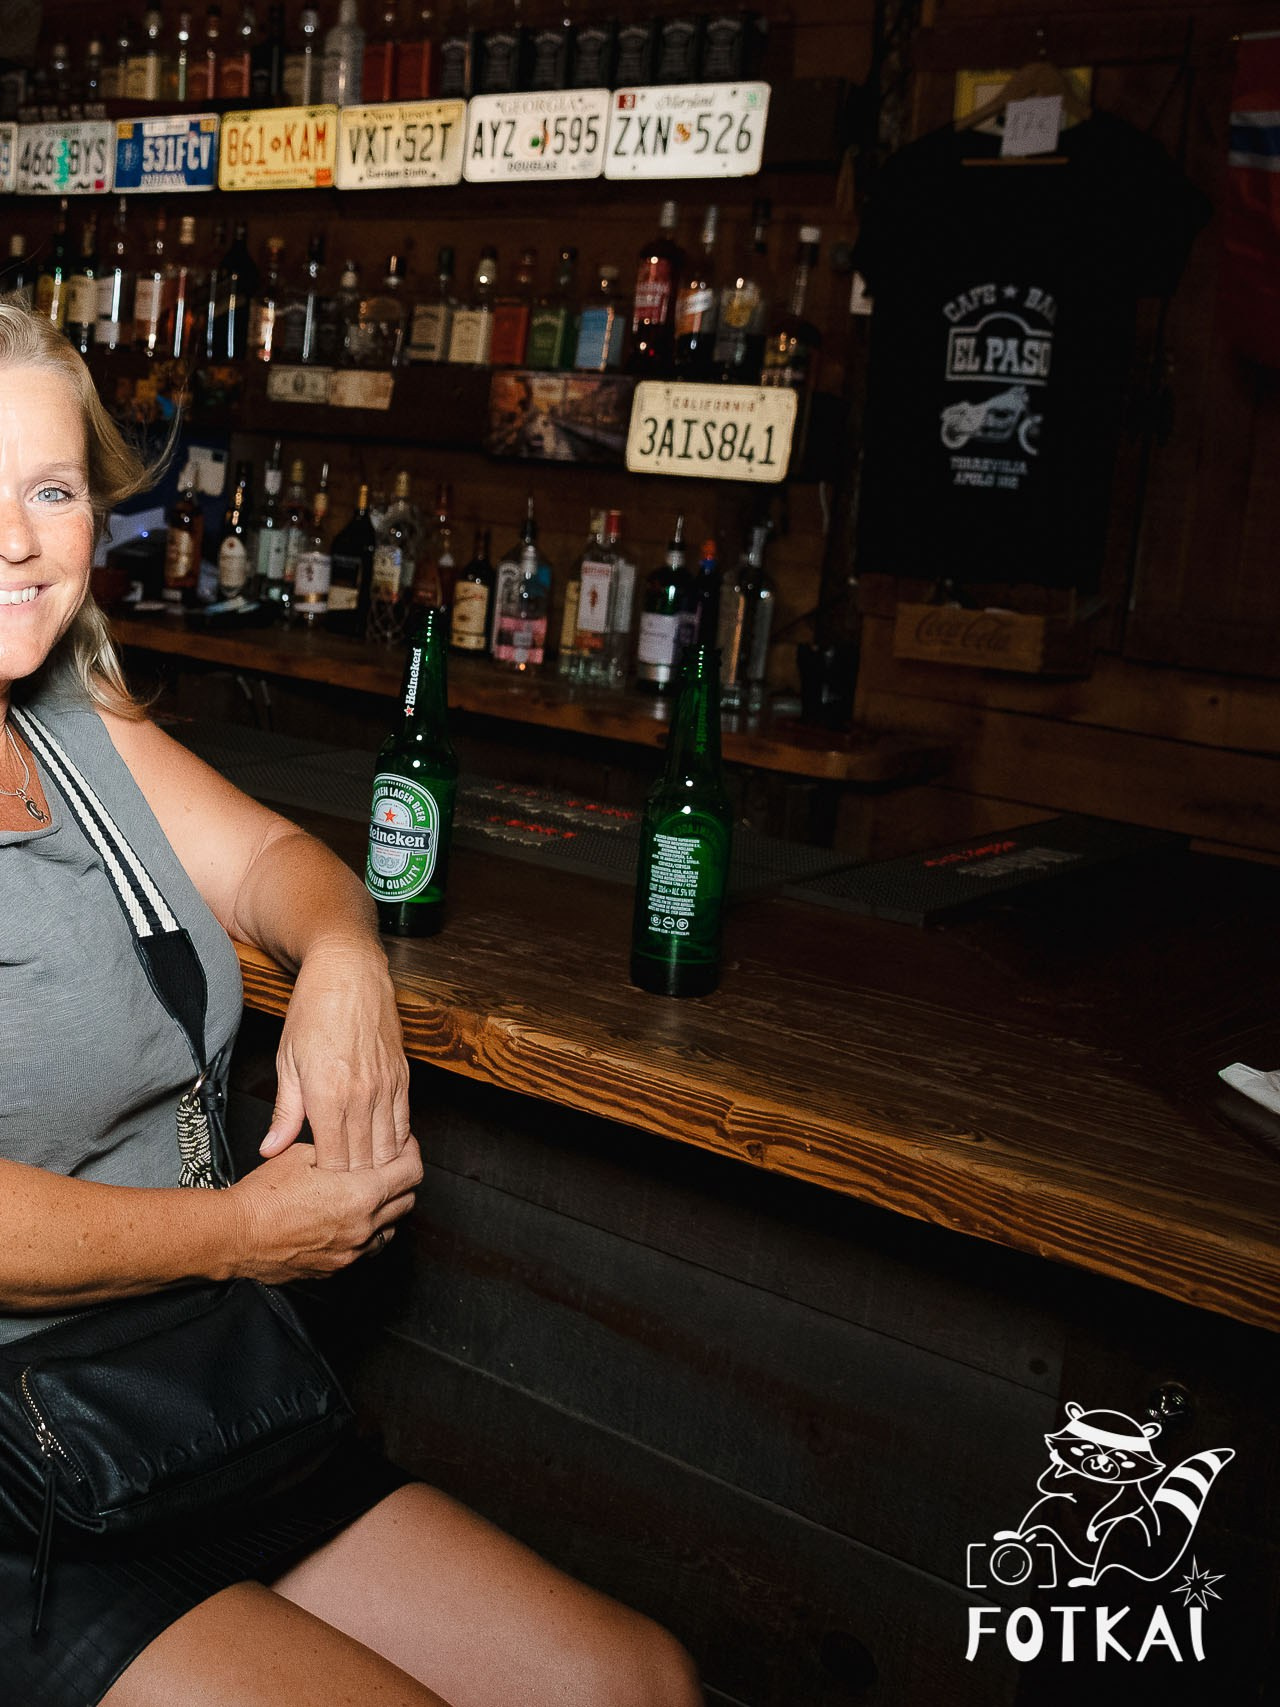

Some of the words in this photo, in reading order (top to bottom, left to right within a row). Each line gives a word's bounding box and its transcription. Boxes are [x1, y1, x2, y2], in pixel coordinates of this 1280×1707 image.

[500, 98, 578, 114] GEORGIA
[349, 125, 392, 164] VXT
[473, 120, 517, 159] AYZ
[614, 115, 672, 156] ZXN
[694, 112, 752, 154] 526
[954, 337, 979, 372] EL
[672, 396, 756, 413] CALIFORNIA
[639, 416, 776, 466] 3AIS841
[405, 648, 422, 705] Heineken
[390, 787, 414, 804] LAGER
[412, 801, 426, 822] BEER
[386, 865, 420, 890] QUALITY
